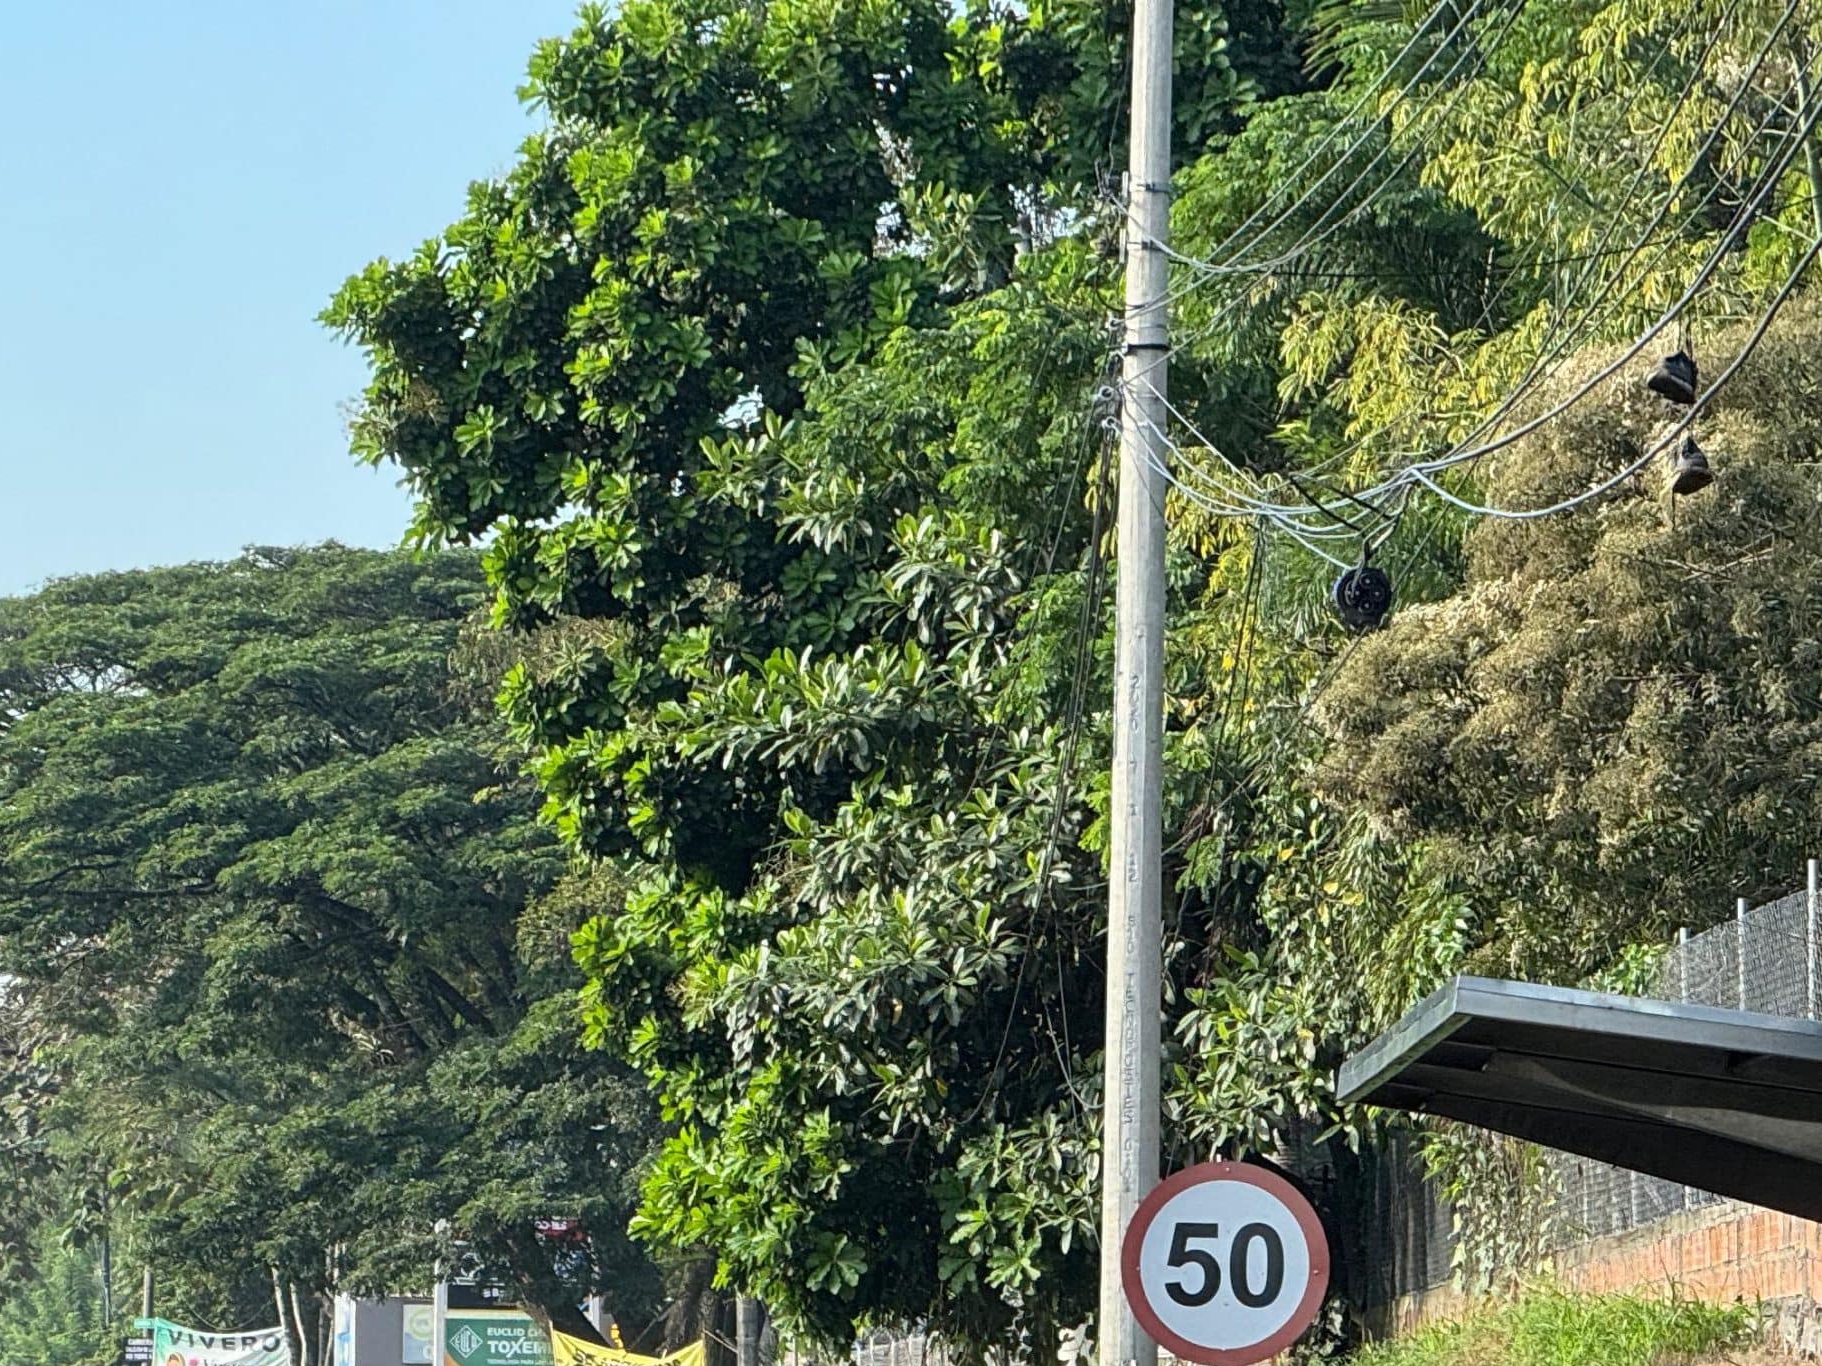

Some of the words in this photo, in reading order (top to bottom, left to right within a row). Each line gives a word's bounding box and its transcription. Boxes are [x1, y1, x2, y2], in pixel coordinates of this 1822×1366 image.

[1164, 1222, 1284, 1309] 50
[168, 1328, 281, 1352] VIVERO
[487, 1327, 525, 1336] EUCLID
